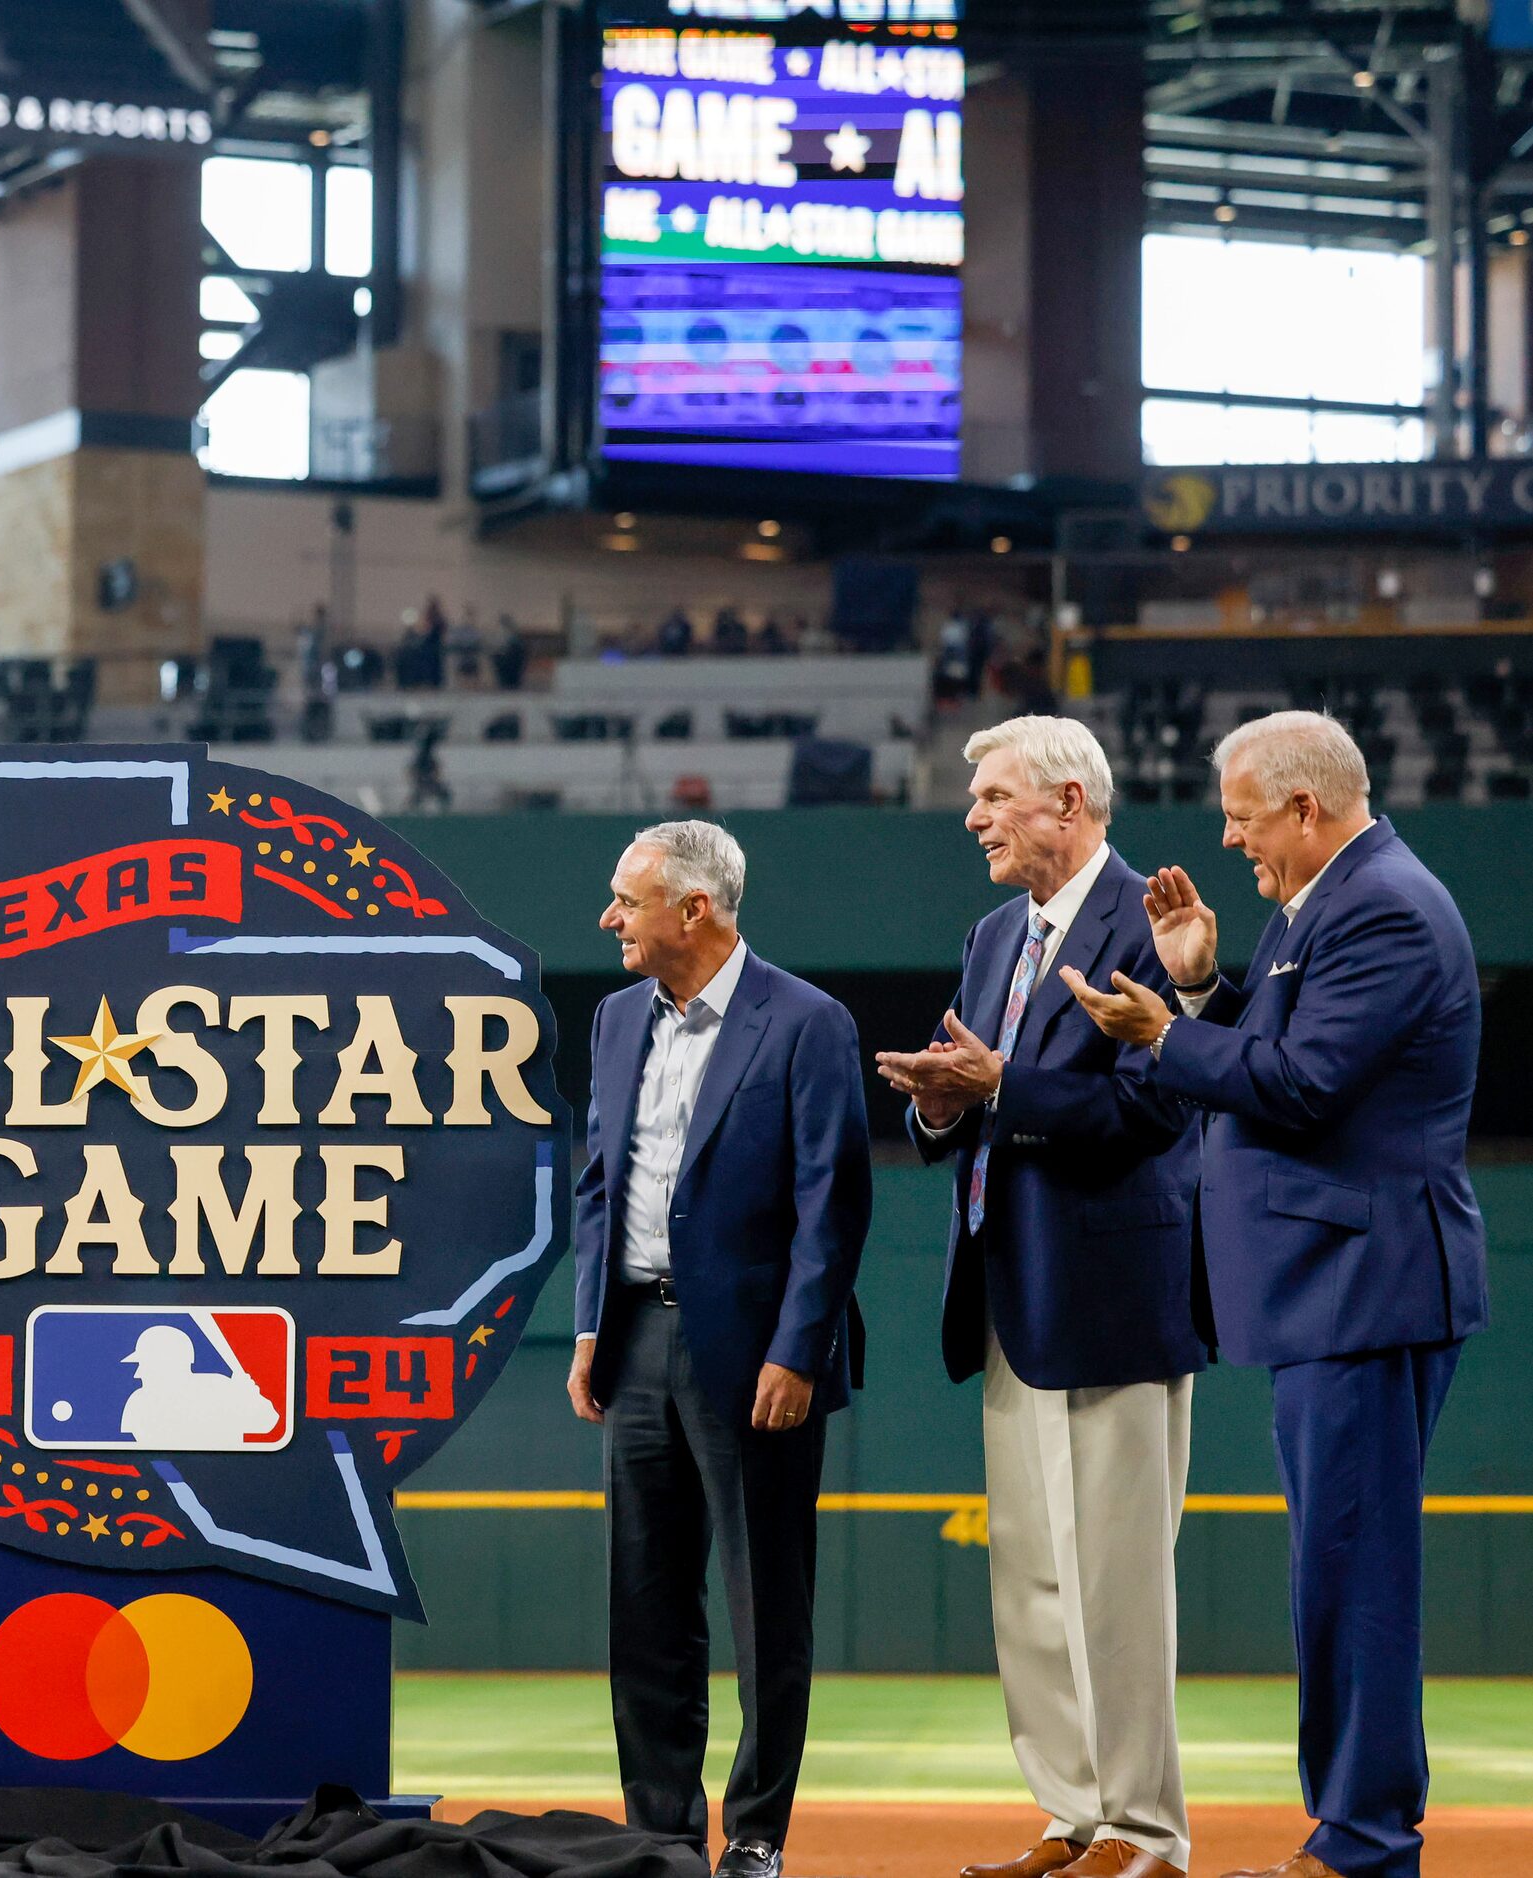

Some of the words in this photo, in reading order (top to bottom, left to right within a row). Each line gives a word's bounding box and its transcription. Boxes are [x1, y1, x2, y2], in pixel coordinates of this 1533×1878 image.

[15, 96, 45, 131] &
[49, 98, 212, 145] RESORTS
[612, 83, 797, 188] GAME
[1222, 471, 1492, 518] PRIORITY
[135, 985, 553, 1128] STAR
[328, 1349, 432, 1405] 24
